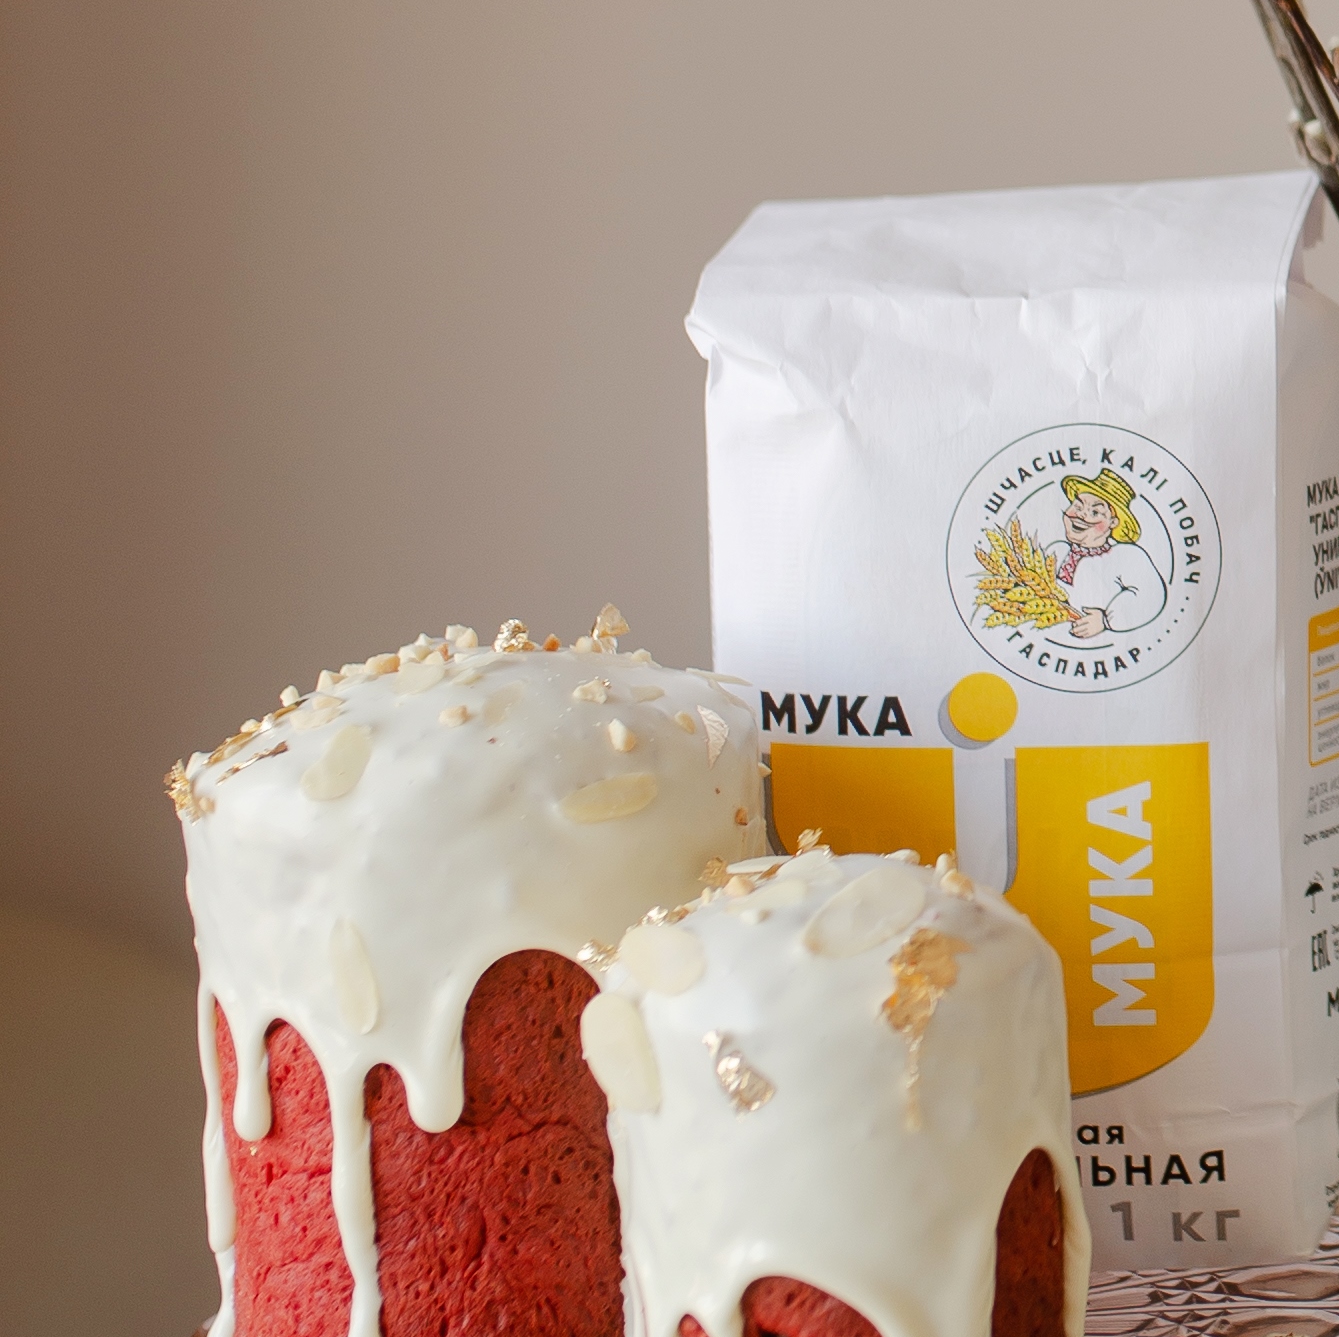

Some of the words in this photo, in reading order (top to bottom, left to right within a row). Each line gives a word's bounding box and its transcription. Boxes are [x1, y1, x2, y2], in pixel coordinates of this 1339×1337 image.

[1307, 475, 1339, 508] МУКА
[984, 447, 1087, 515] ШЧАСЦЕ,
[1100, 447, 1168, 491] КАЛІ
[1169, 498, 1202, 584] ПОБАЧ
[1007, 630, 1143, 680] ГАСПАДАР
[760, 689, 912, 737] МУКА
[1086, 781, 1158, 1027] МУКА
[1077, 1124, 1125, 1145] ая
[1076, 1149, 1226, 1188] ЬНАЯ
[1110, 1201, 1135, 1241] 1
[1172, 1209, 1241, 1242] кг
